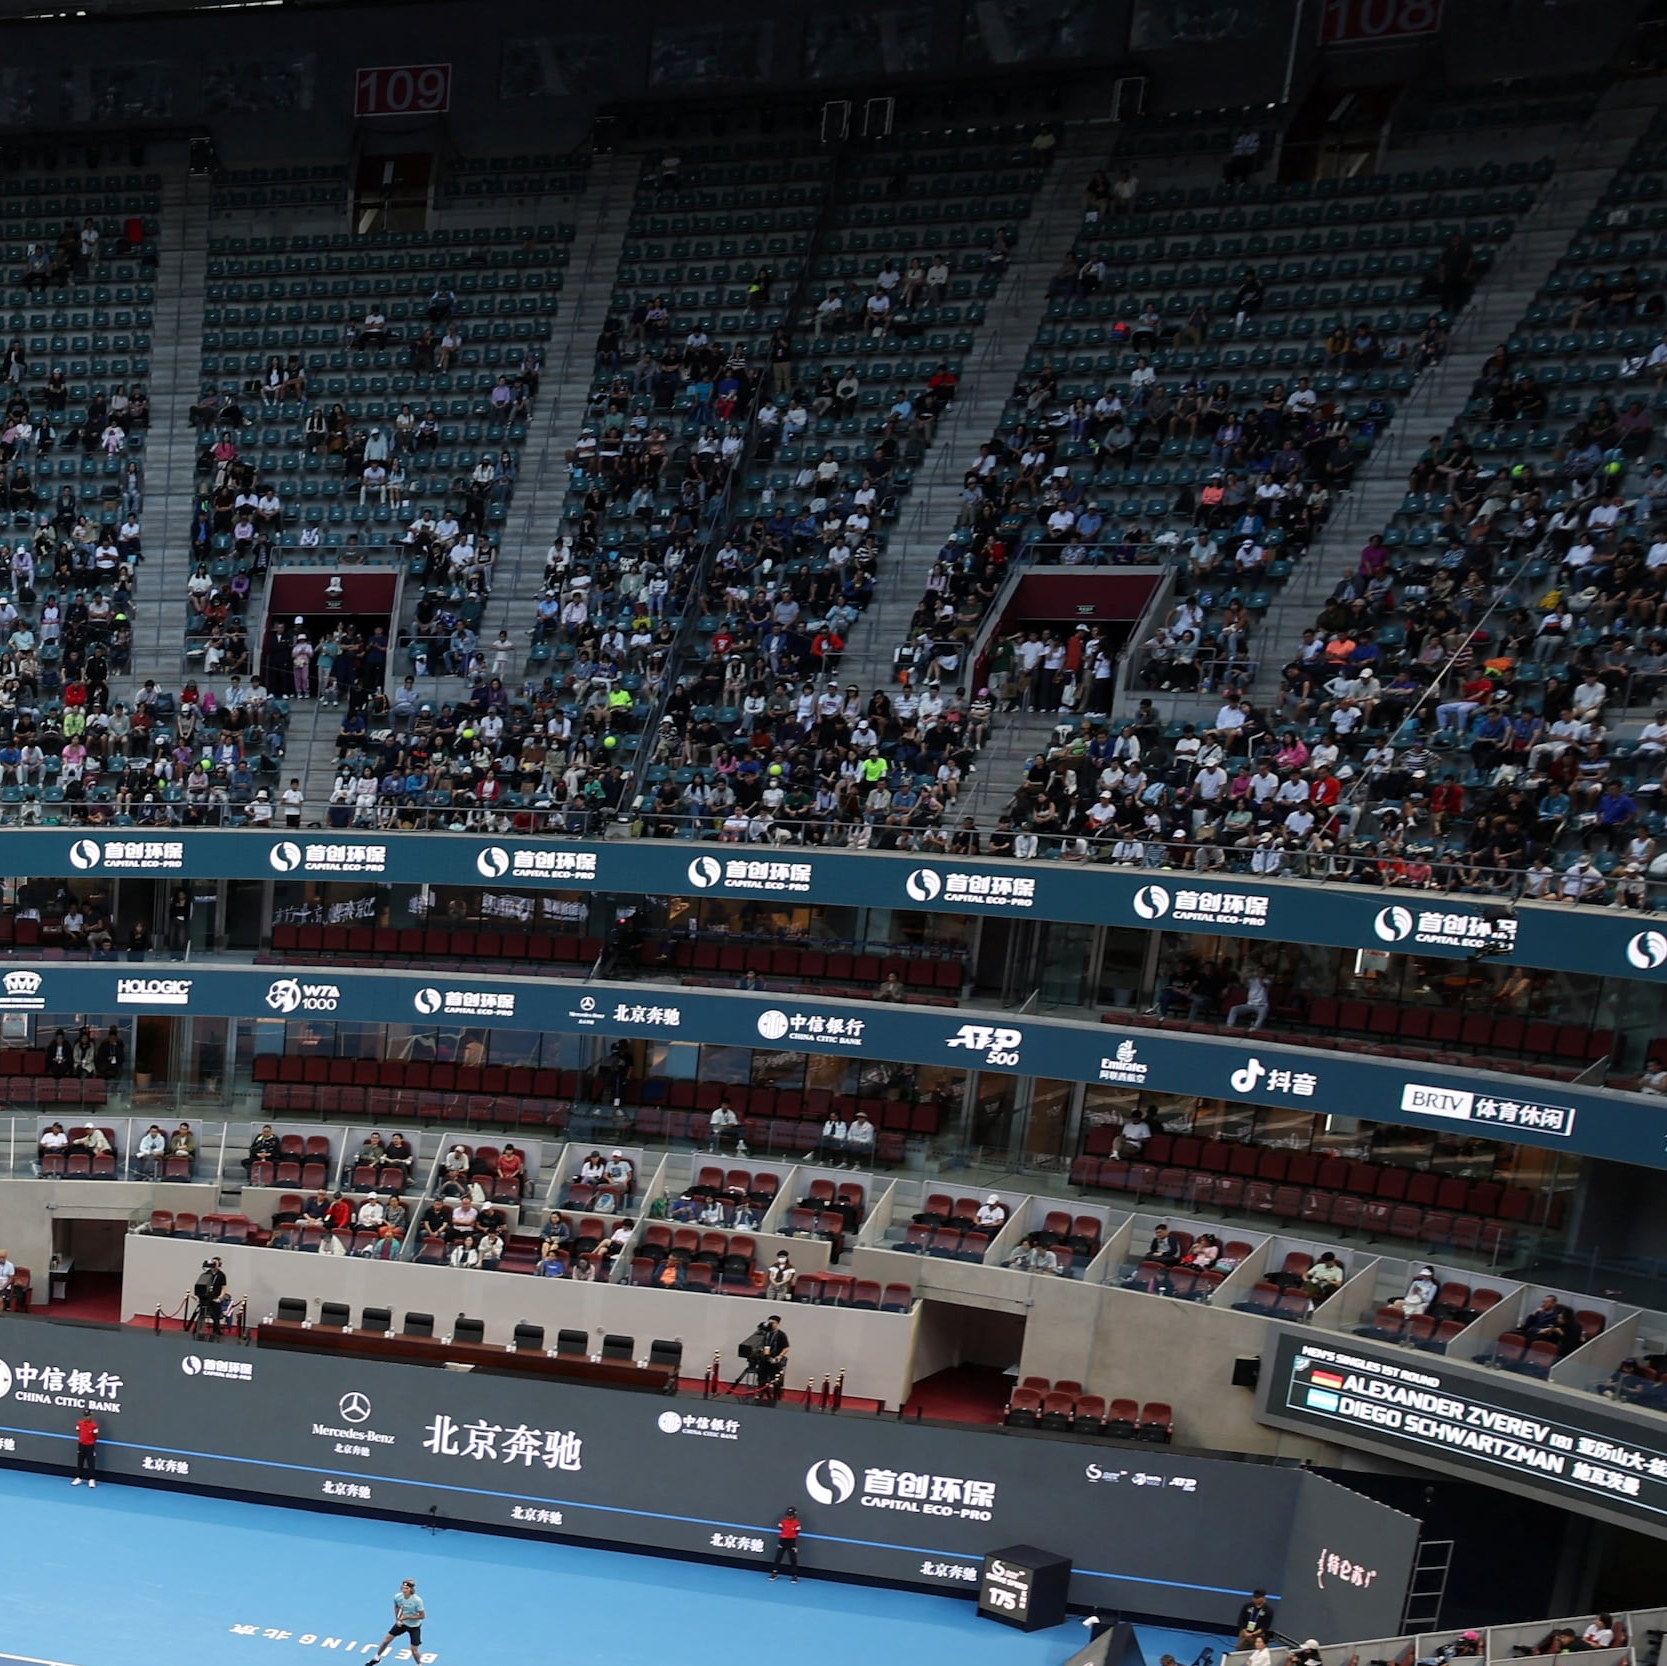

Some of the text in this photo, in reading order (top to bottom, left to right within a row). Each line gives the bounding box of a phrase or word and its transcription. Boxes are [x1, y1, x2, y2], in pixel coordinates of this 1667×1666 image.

[1326, 0, 1437, 40] 108
[359, 68, 445, 112] 109
[104, 842, 184, 860] 首创环保
[305, 844, 387, 864] 首创环保
[514, 850, 597, 871] 首创环保
[140, 860, 183, 868] ECO-PRO
[512, 869, 596, 880] CAPITAL ECO-PRO
[726, 860, 812, 883] 首创环保
[946, 873, 1036, 898] 首创环保
[944, 893, 1034, 907] CAPITAL ECO-PRO
[1175, 890, 1269, 917] 首创环保
[117, 979, 189, 994] HOLOGIC
[303, 984, 341, 998] WTA
[303, 998, 338, 1011] 1000
[445, 991, 516, 1010] 首创环保
[613, 1003, 681, 1027] 北京奔驰
[789, 1013, 865, 1037] 中信银行
[945, 1024, 1023, 1052] ATP
[986, 1051, 1021, 1067] 500
[1100, 1057, 1149, 1074] Emirates
[1266, 1068, 1318, 1097] 抖音
[1412, 1091, 1465, 1112] BRTV
[1475, 1097, 1566, 1130] 体育休闲
[1302, 1345, 1441, 1389] MEN'S SINGLES 1ST ROUND
[14, 1360, 124, 1400] 中信银行
[14, 1390, 121, 1414] CHINA CITIC BANK
[1342, 1374, 1574, 1451] ALEXANDER ZVEREV [8]
[310, 1422, 397, 1445] Mercedes-Benz
[682, 1413, 742, 1434] 中信银行
[1338, 1396, 1566, 1474] DIEGO SCHWARTZMAN
[333, 1442, 371, 1458] 北京奔驰
[422, 1413, 584, 1472] 北京奔驰
[141, 1455, 190, 1476] 北京奔驰
[321, 1479, 372, 1500] 北京奔驰
[862, 1467, 996, 1508] 首创环保
[1570, 1461, 1641, 1497] 施瓦茨曼
[509, 1505, 564, 1526] 北京奔驰
[860, 1495, 993, 1522] CAPITAL ECO-PRO
[709, 1531, 765, 1554] 北京奔驰
[920, 1560, 978, 1583] 北京奔驰
[987, 1586, 1019, 1611] 175
